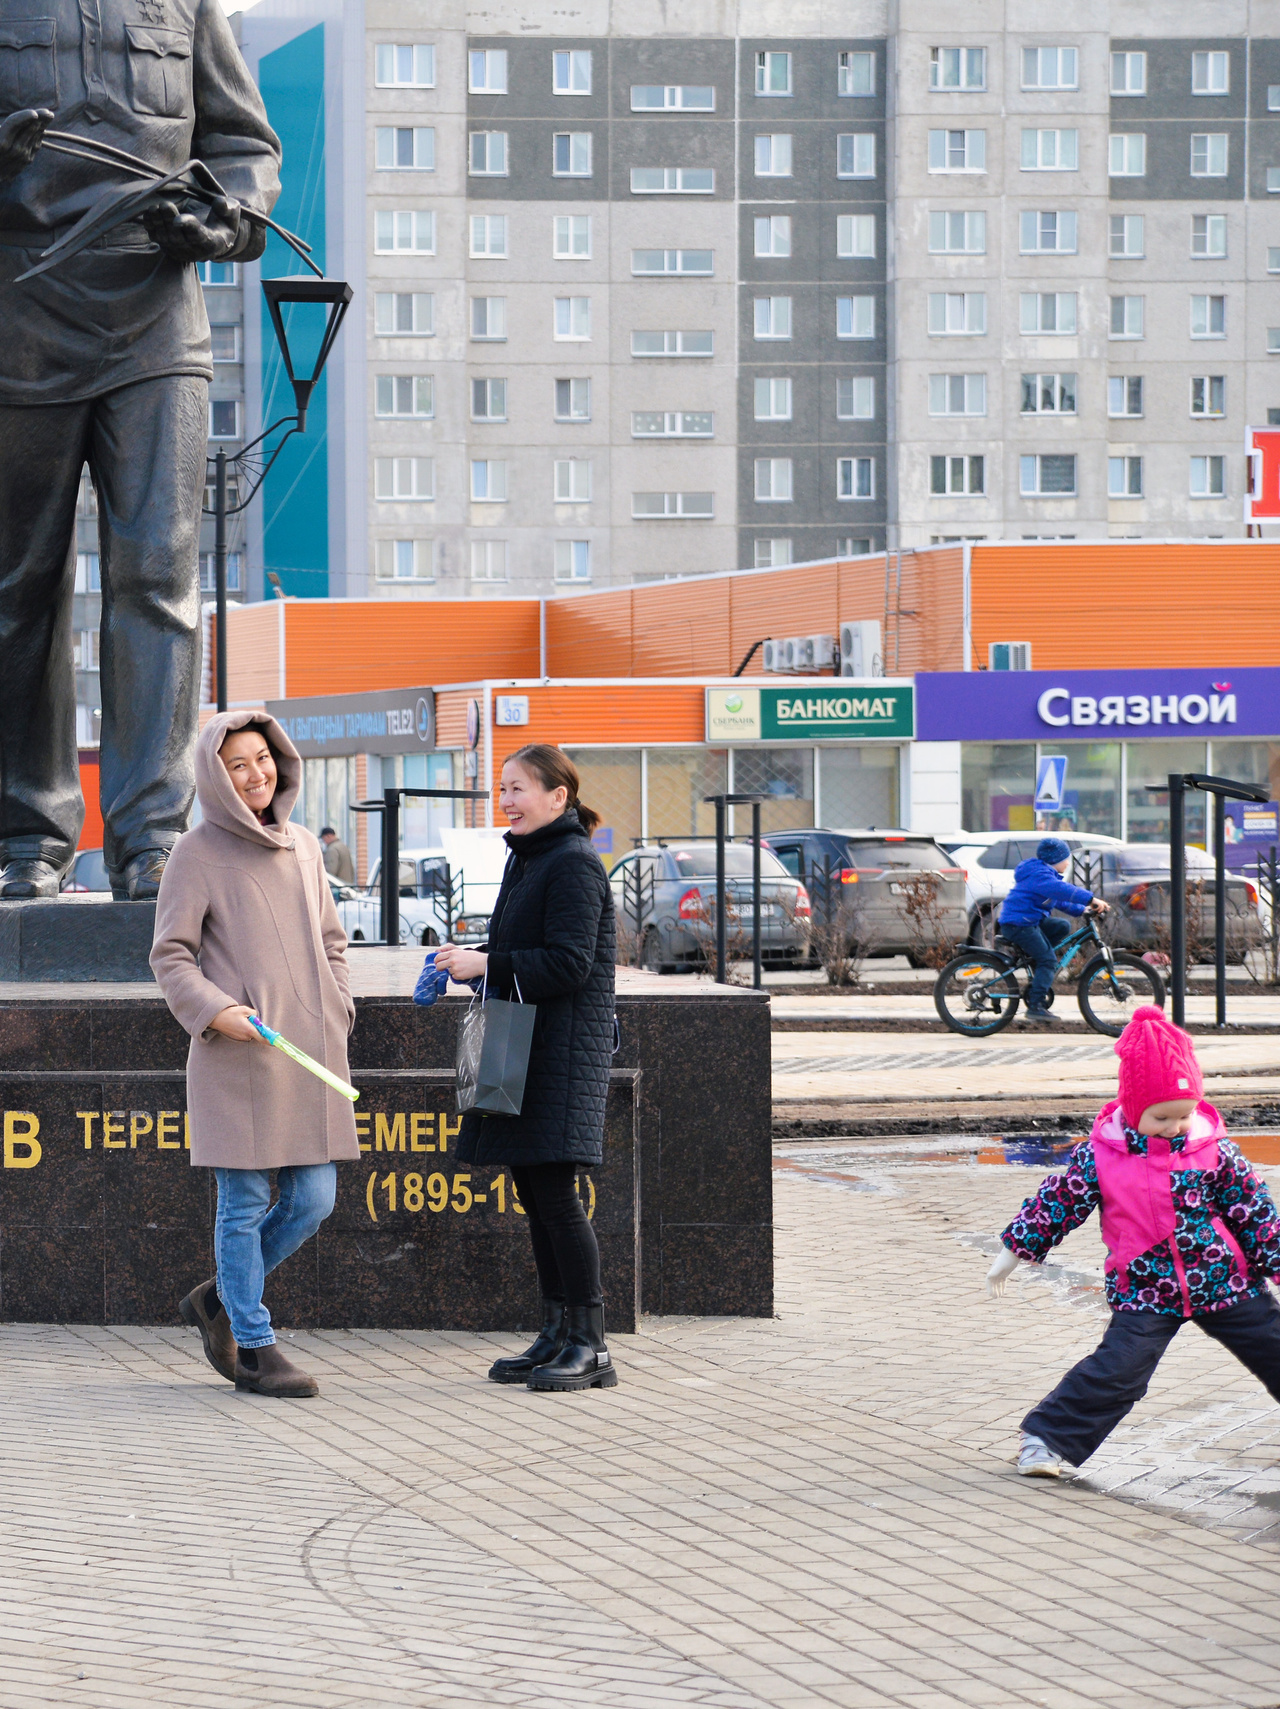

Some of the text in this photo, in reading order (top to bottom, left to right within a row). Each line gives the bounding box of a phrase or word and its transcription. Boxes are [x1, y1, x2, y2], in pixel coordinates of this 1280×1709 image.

[776, 698, 897, 718] БАНКОМАТ
[1037, 682, 1238, 727] Связной
[386, 709, 414, 735] TELE2
[505, 709, 521, 722] 30
[712, 717, 755, 725] СБЕРБАНК
